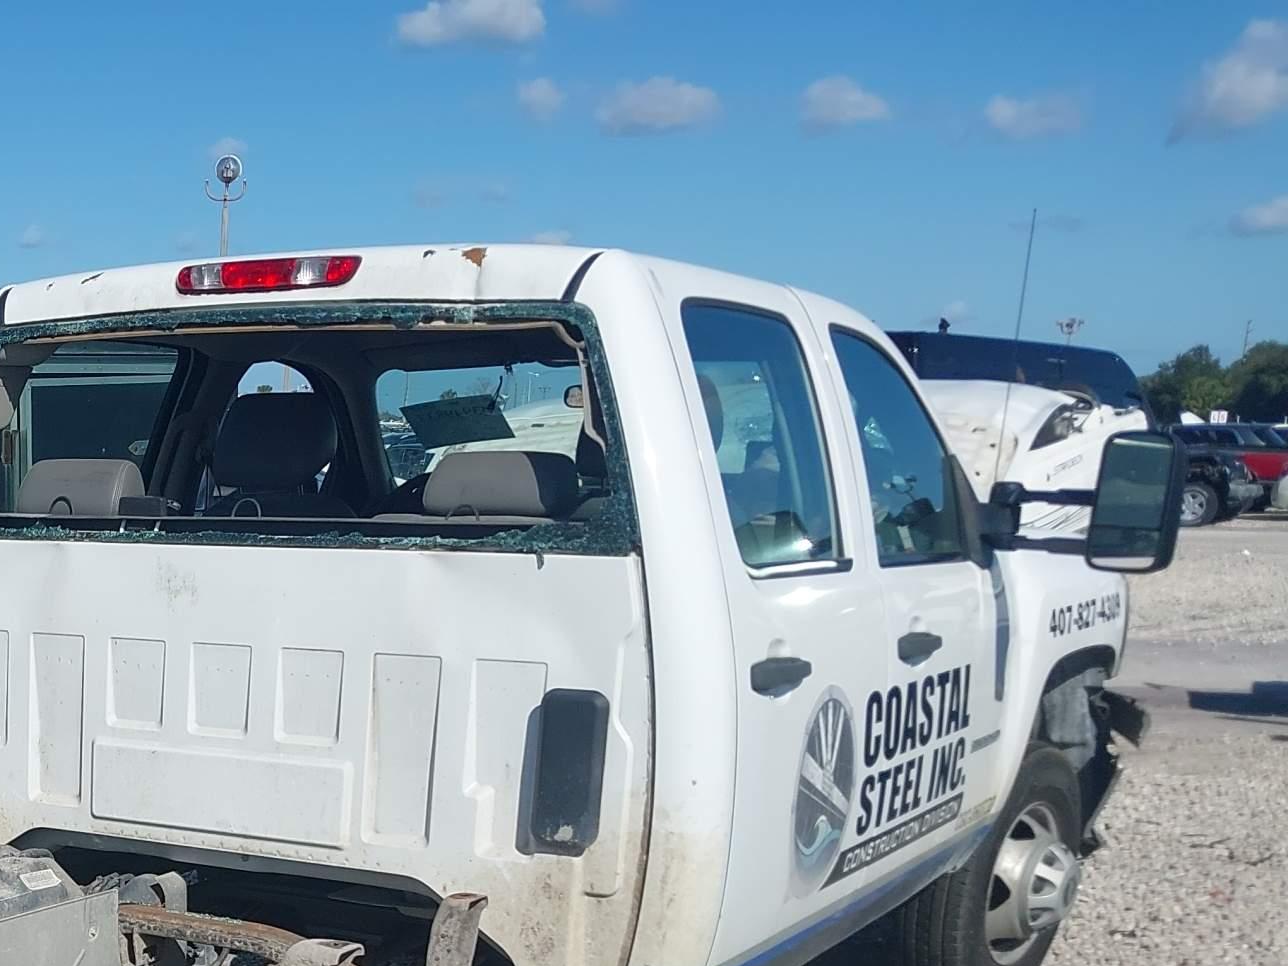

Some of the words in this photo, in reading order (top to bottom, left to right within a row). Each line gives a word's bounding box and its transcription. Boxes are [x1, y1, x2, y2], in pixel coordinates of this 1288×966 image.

[864, 664, 971, 768] COASTAL
[856, 755, 924, 836] STEEL
[926, 737, 966, 804] INC.
[843, 816, 921, 872] CONSTRUCTION
